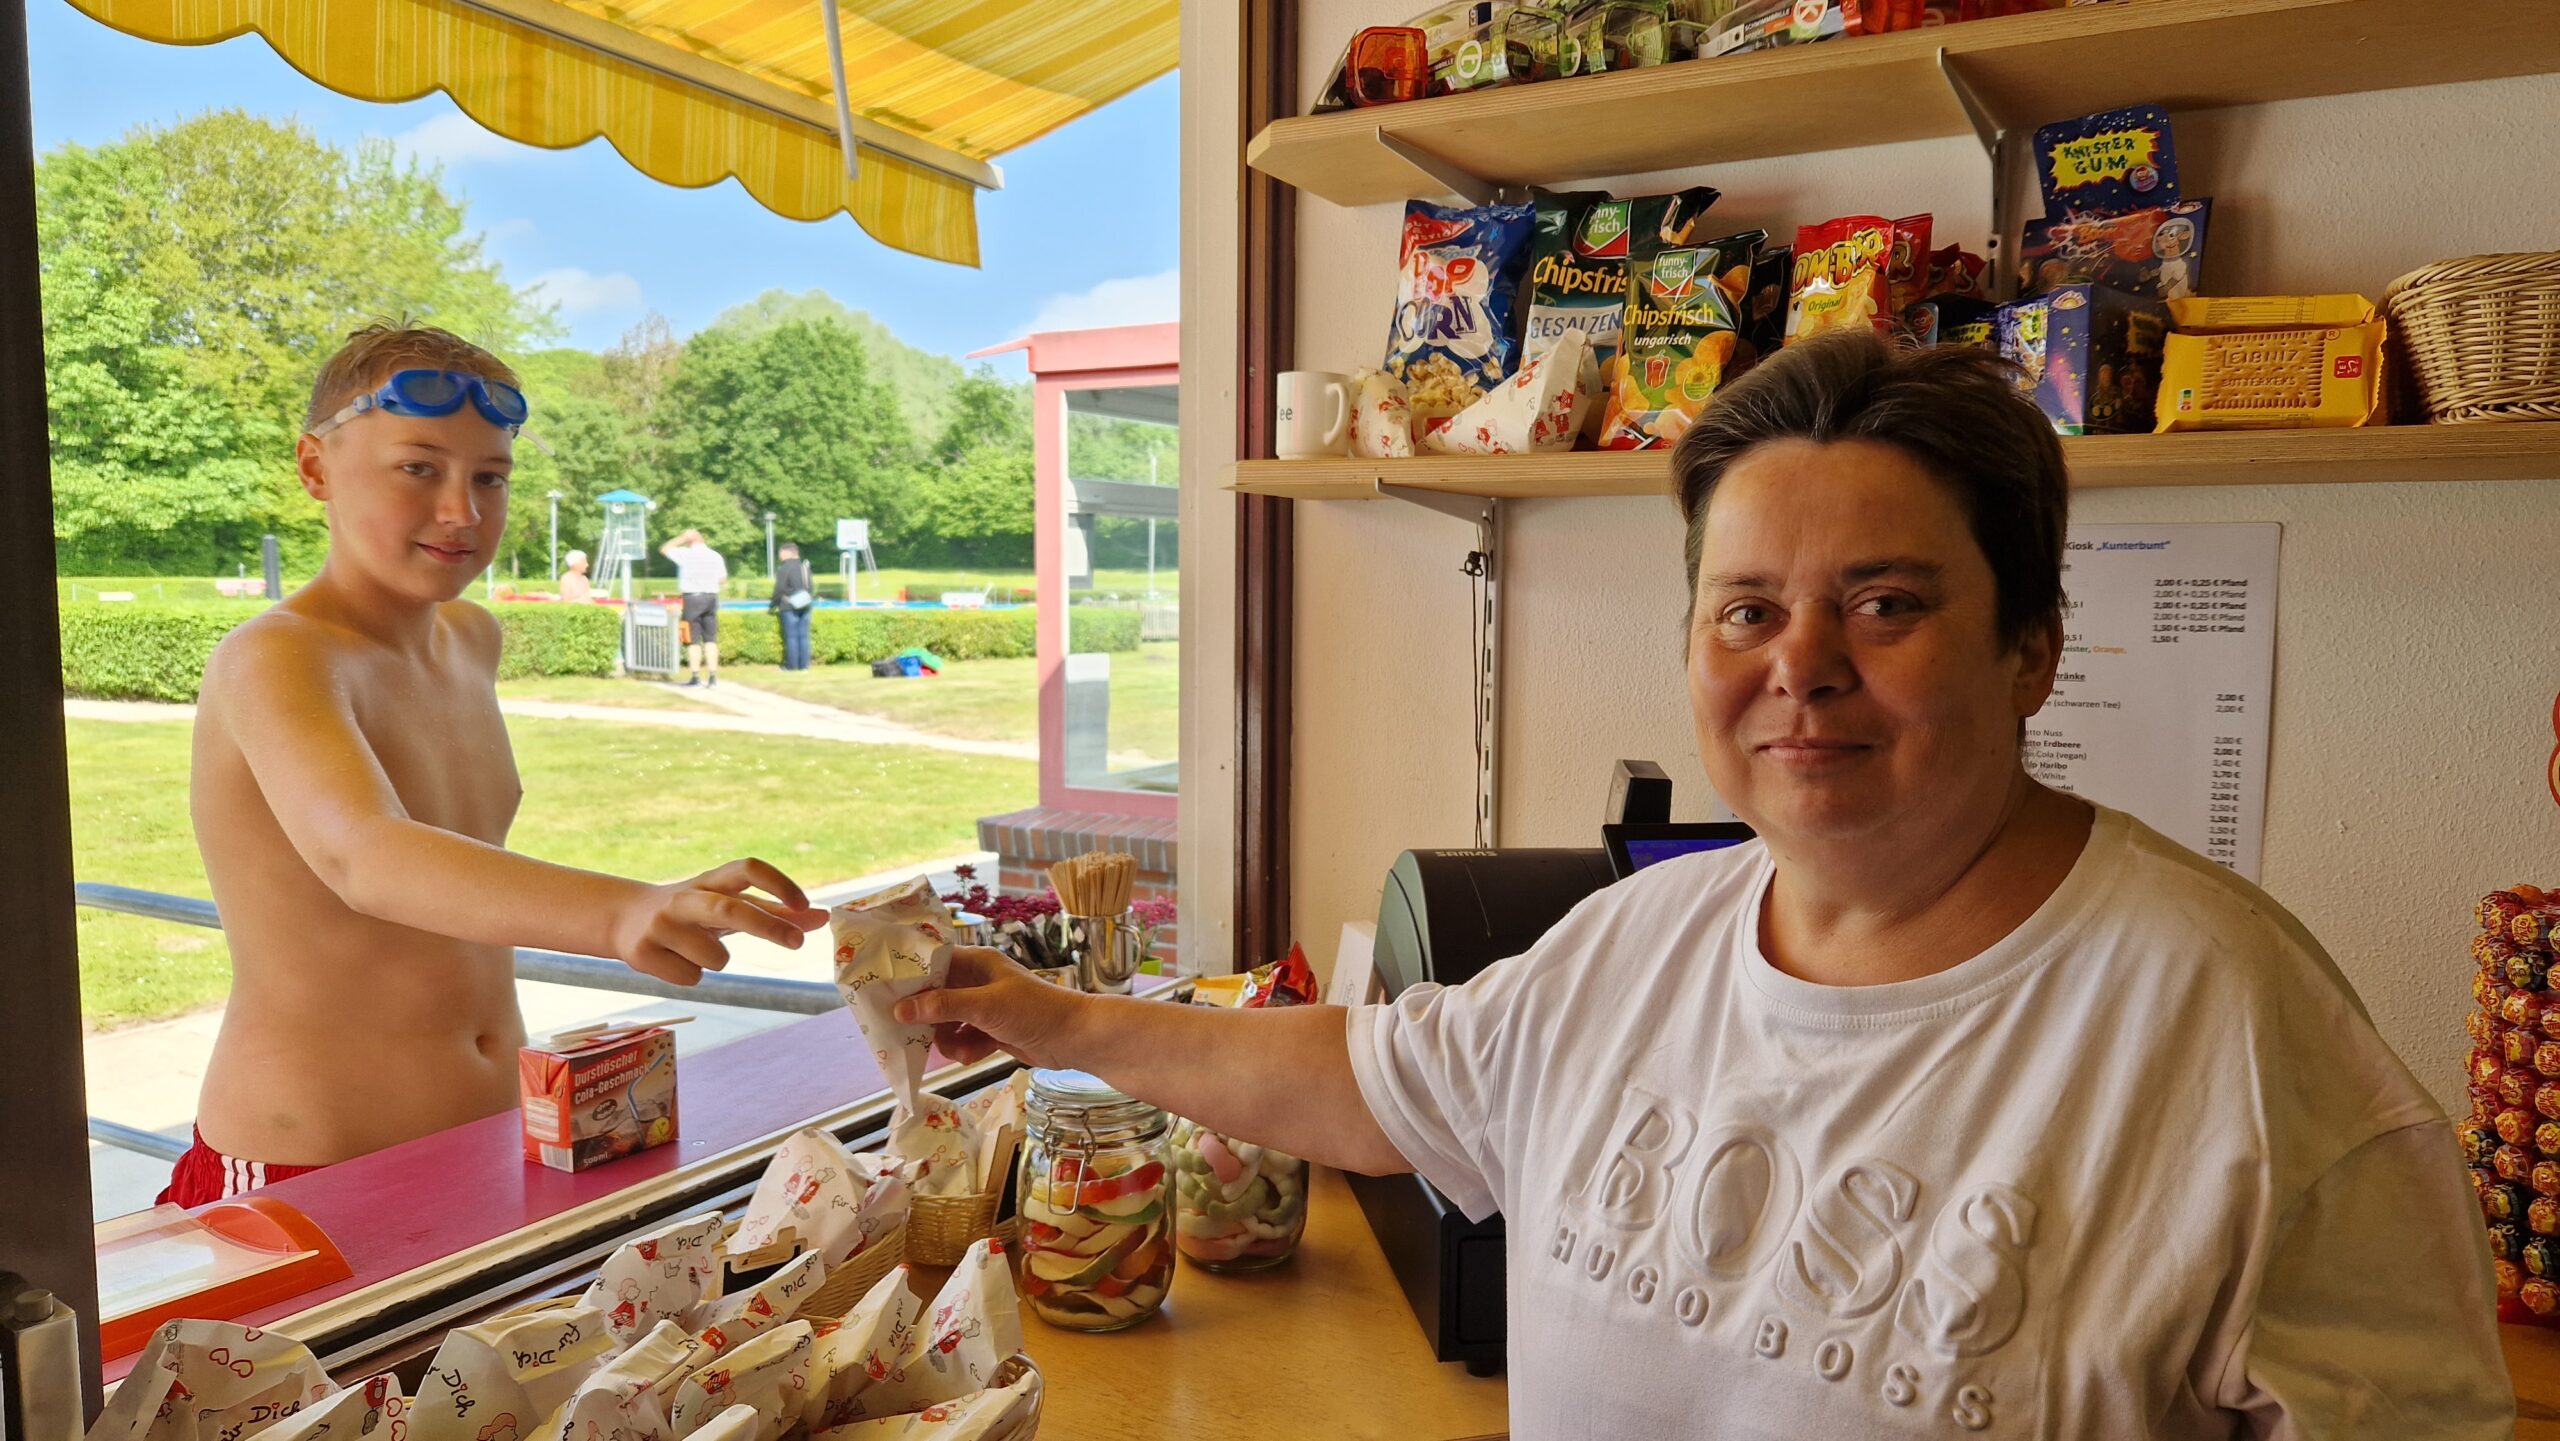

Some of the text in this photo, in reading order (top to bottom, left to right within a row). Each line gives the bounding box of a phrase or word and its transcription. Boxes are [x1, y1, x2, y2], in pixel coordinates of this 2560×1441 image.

[2063, 137, 2136, 159] KNISTER
[2074, 155, 2128, 175] GUM
[1659, 255, 1688, 269] funny-
[1532, 256, 1627, 294] Chipsfris
[1661, 266, 1690, 279] frisch
[1808, 295, 1842, 312] Original
[1623, 302, 1714, 330] Chipsfrisch
[1634, 333, 1692, 348] ungarisch
[2223, 349, 2301, 369] LEIBNIZ
[2065, 541, 2094, 551] Kiosk
[2056, 672, 2086, 681] tränke
[2054, 700, 2100, 708] (schwarzen
[2102, 701, 2121, 709] Tee)
[2056, 752, 2087, 760] (vegan)
[850, 972, 879, 991] Dich
[574, 1050, 639, 1088] Durstlöscher
[575, 1062, 652, 1105] Cola-Geschmack
[1566, 1088, 2037, 1357] BOSS
[1550, 1225, 1993, 1431] HUGO BOSS
[513, 1350, 557, 1369] Dich
[442, 1368, 476, 1418] Dich
[248, 1400, 300, 1424] Dich
